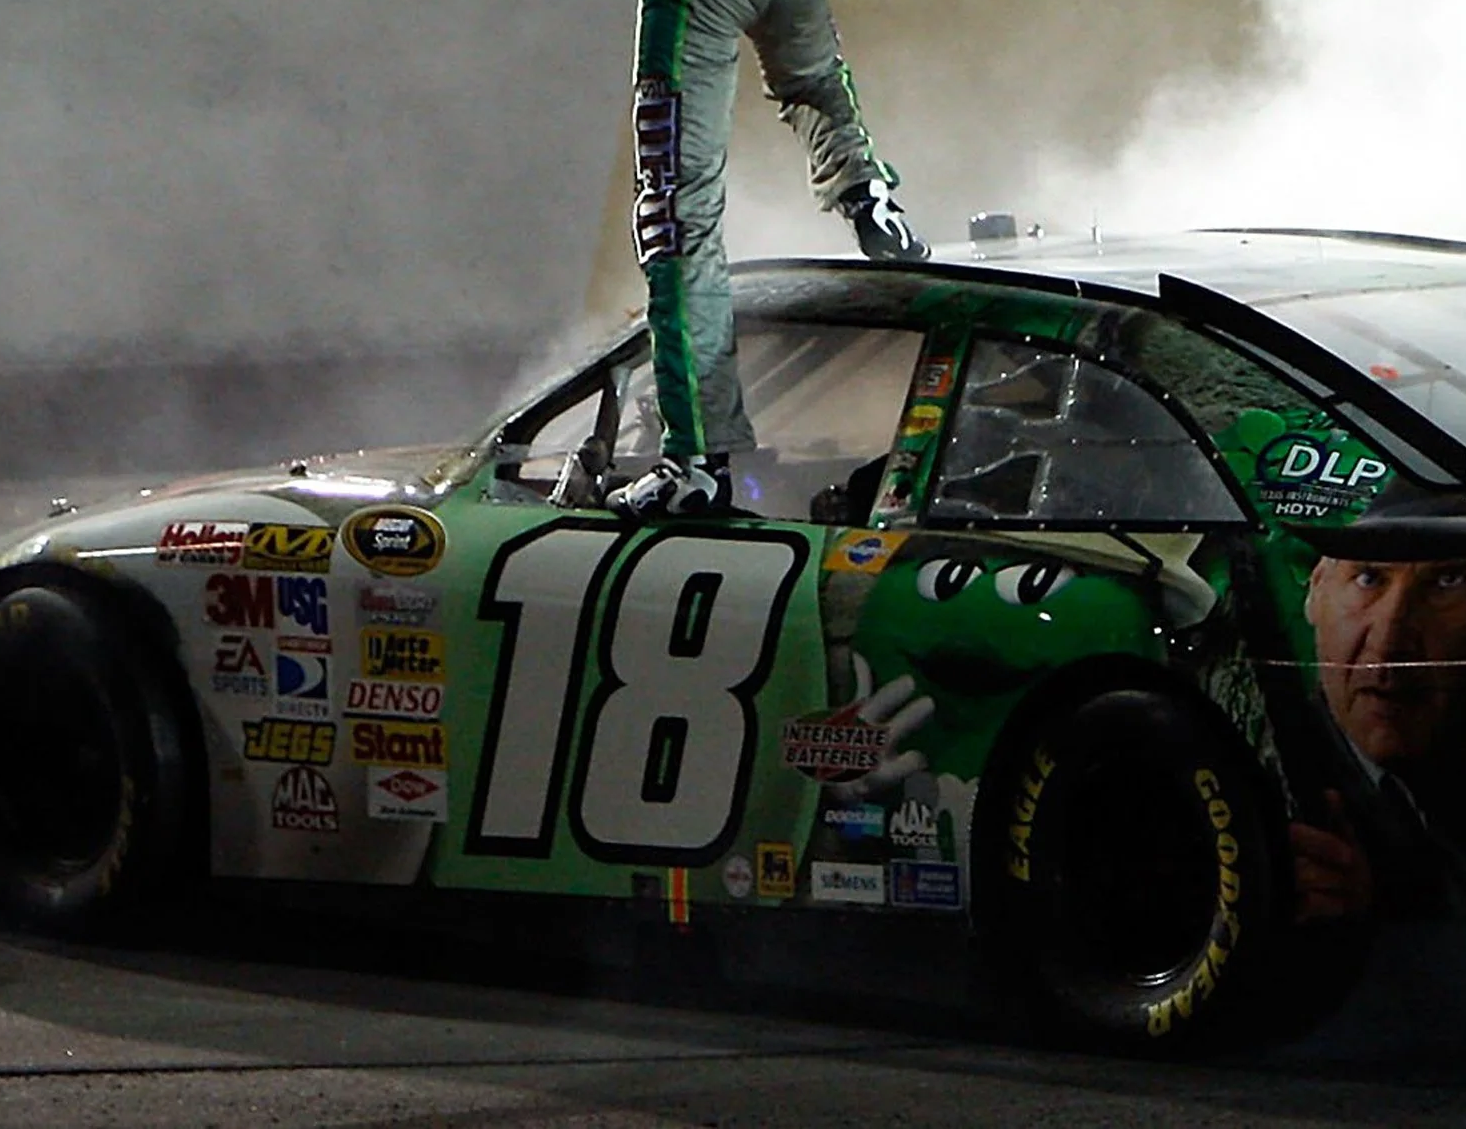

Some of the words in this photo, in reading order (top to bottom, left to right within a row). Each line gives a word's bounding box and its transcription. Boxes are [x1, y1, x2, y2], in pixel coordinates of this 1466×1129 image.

[1281, 443, 1387, 487] DLP
[1275, 502, 1329, 518] HDTV
[205, 573, 275, 629] 3M
[278, 576, 329, 636] USG
[215, 635, 265, 675] EA
[347, 681, 442, 715] DENSO
[467, 518, 808, 863] 18
[244, 718, 336, 766] JEGS
[783, 724, 887, 747] INTERSTATE
[784, 746, 880, 768] BATTERIES
[274, 812, 339, 831] TOOLS
[1145, 766, 1241, 1038] GOODYEAR
